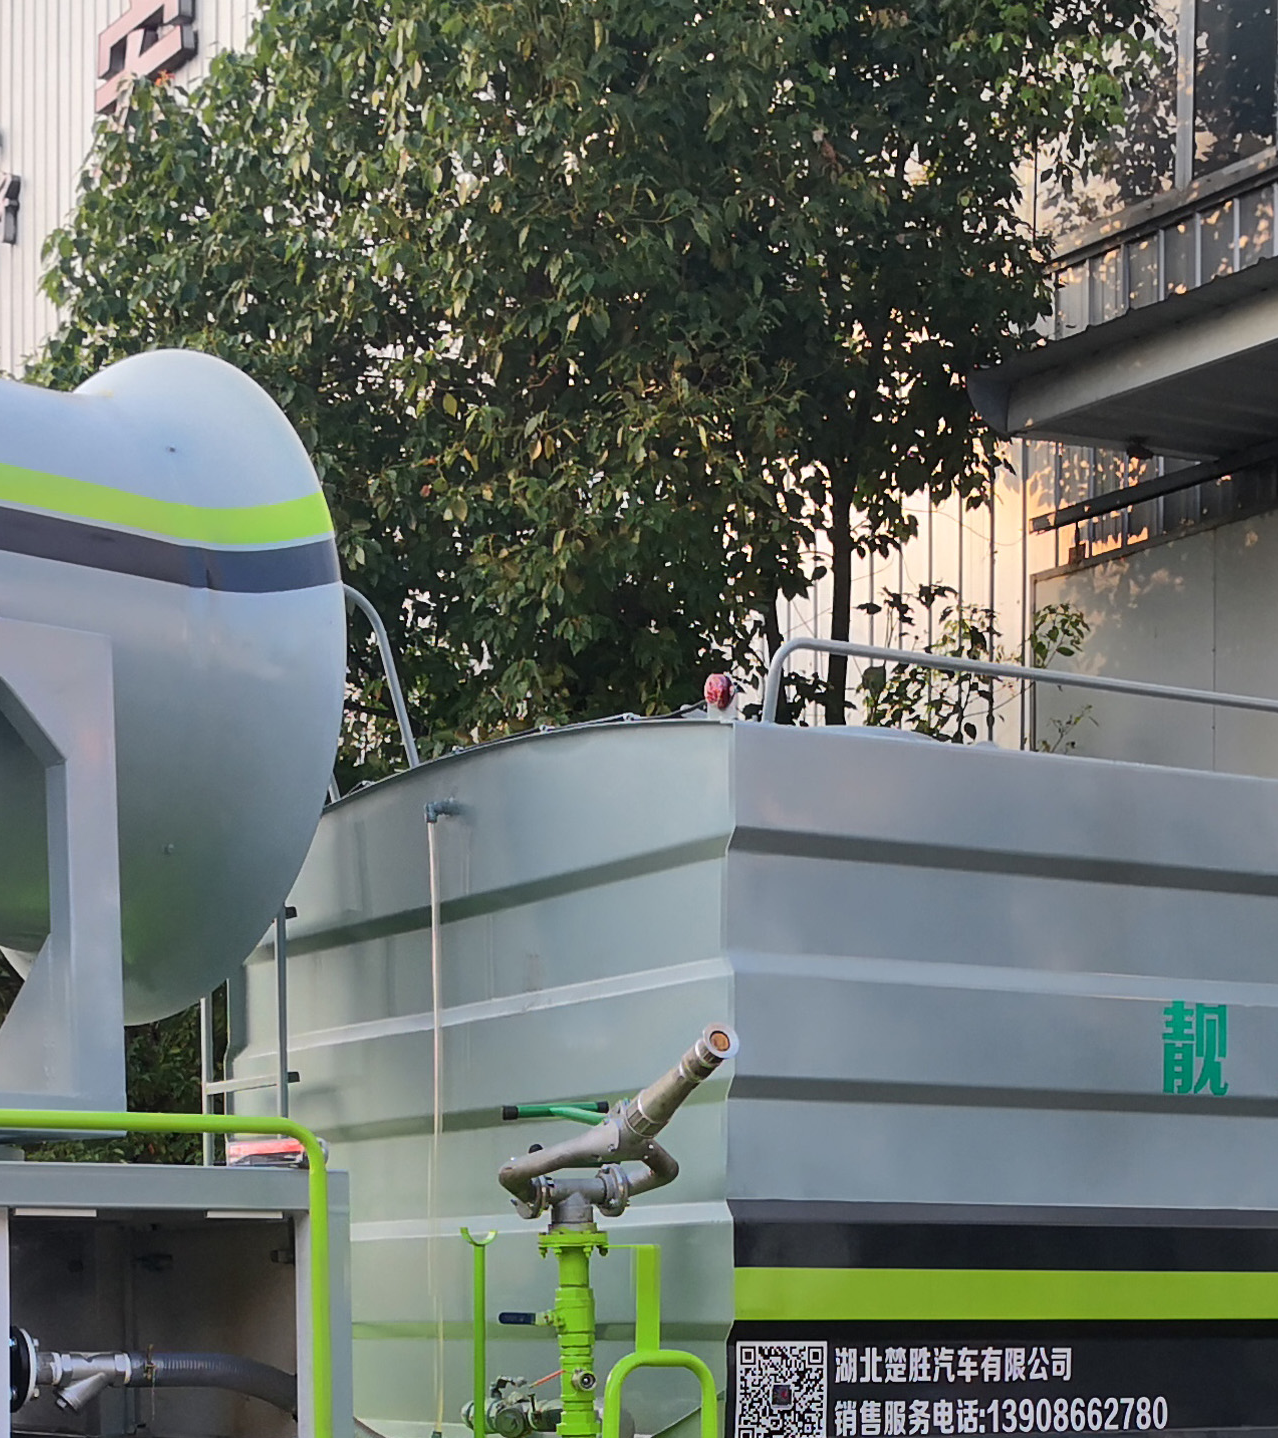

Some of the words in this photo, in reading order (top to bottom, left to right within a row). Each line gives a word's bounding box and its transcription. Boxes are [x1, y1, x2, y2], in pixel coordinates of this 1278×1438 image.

[834, 1347, 1072, 1383] 湖北楚胜汽车有限公司
[834, 1396, 1168, 1437] 销售服务电话:13908662780
